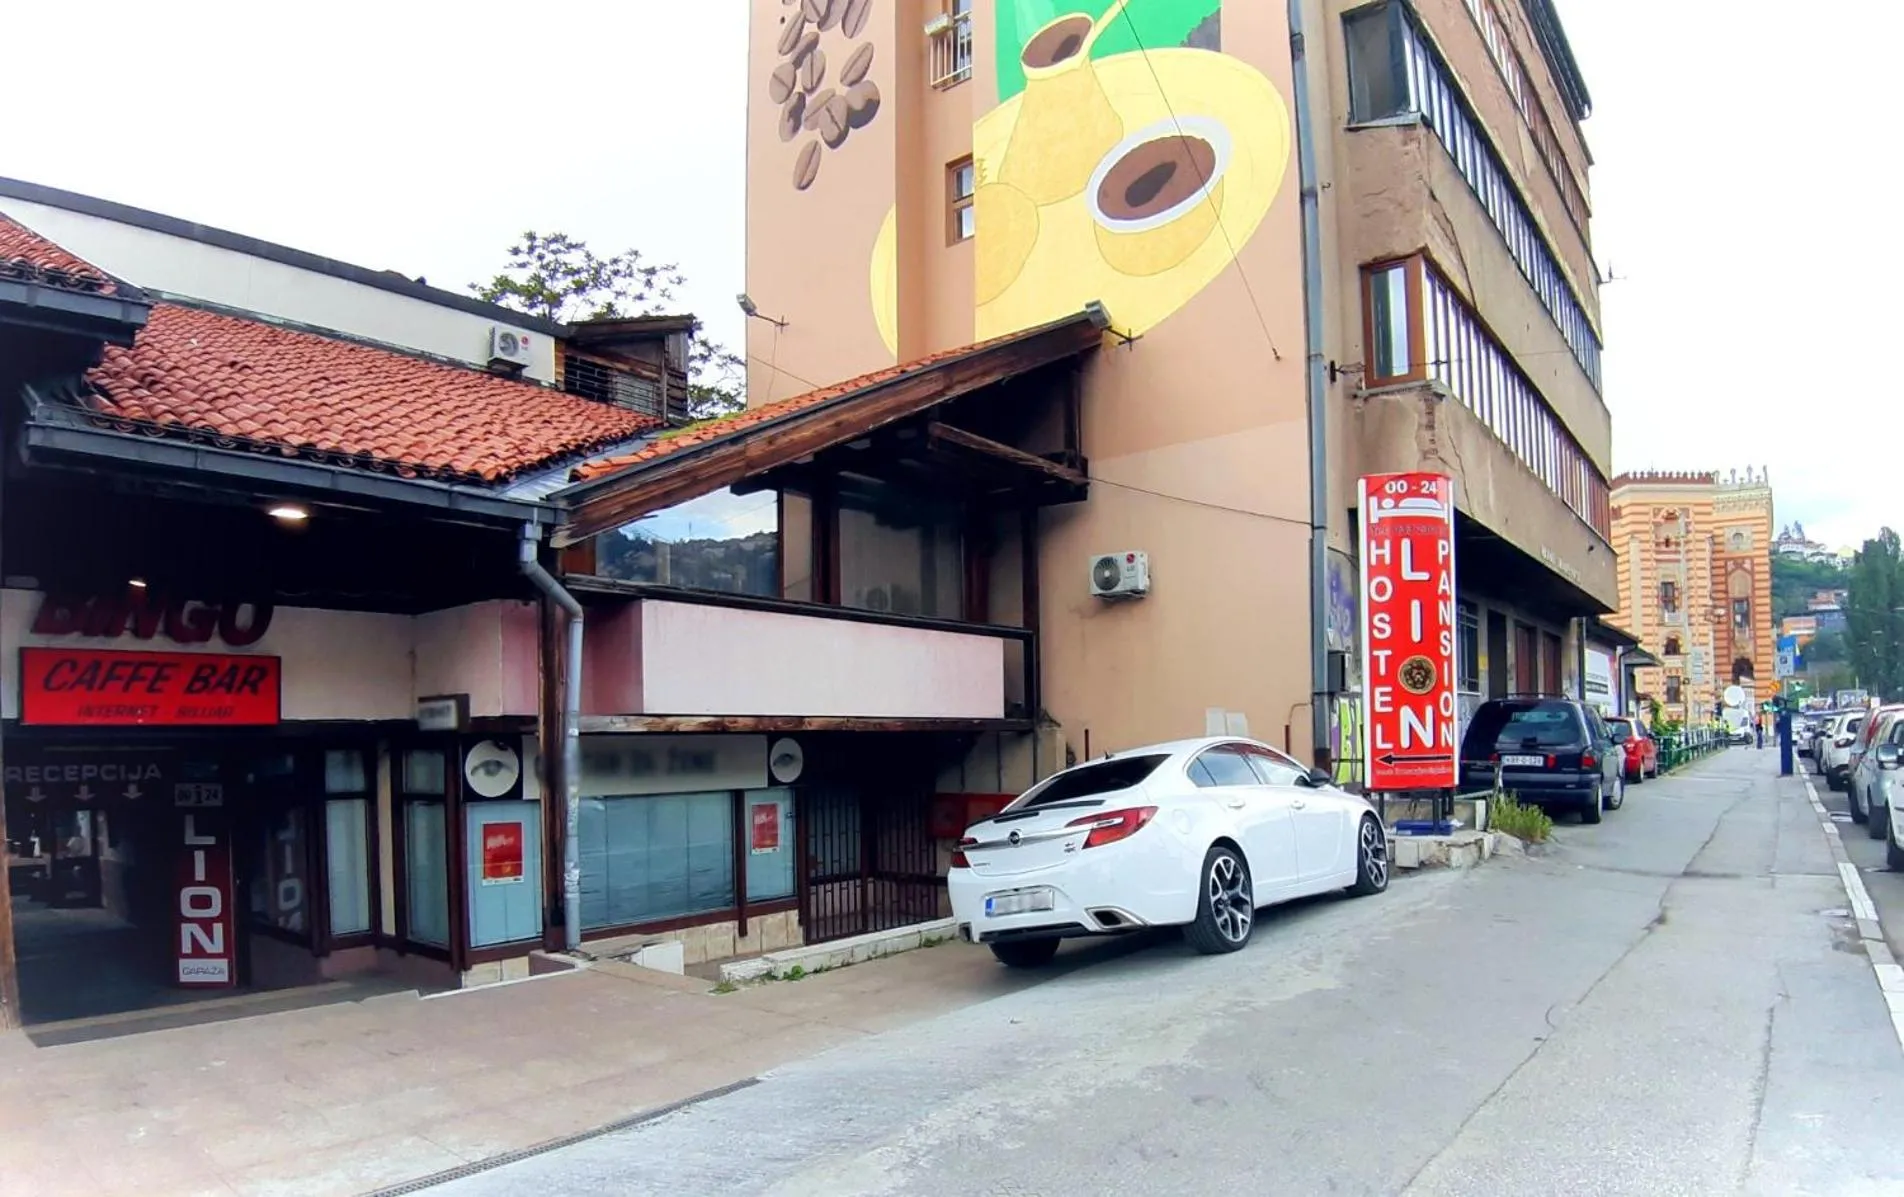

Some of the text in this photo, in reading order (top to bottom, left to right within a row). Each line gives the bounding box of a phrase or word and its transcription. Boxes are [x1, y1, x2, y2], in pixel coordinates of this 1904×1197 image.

[1384, 480, 1408, 494] 00
[1420, 480, 1437, 494] 24
[43, 658, 269, 697] CAFFE BAR
[1369, 539, 1393, 750] HOSTEL
[1437, 539, 1453, 748] PANSION
[5, 763, 162, 783] RECEPCIJA
[180, 814, 225, 955] LION
